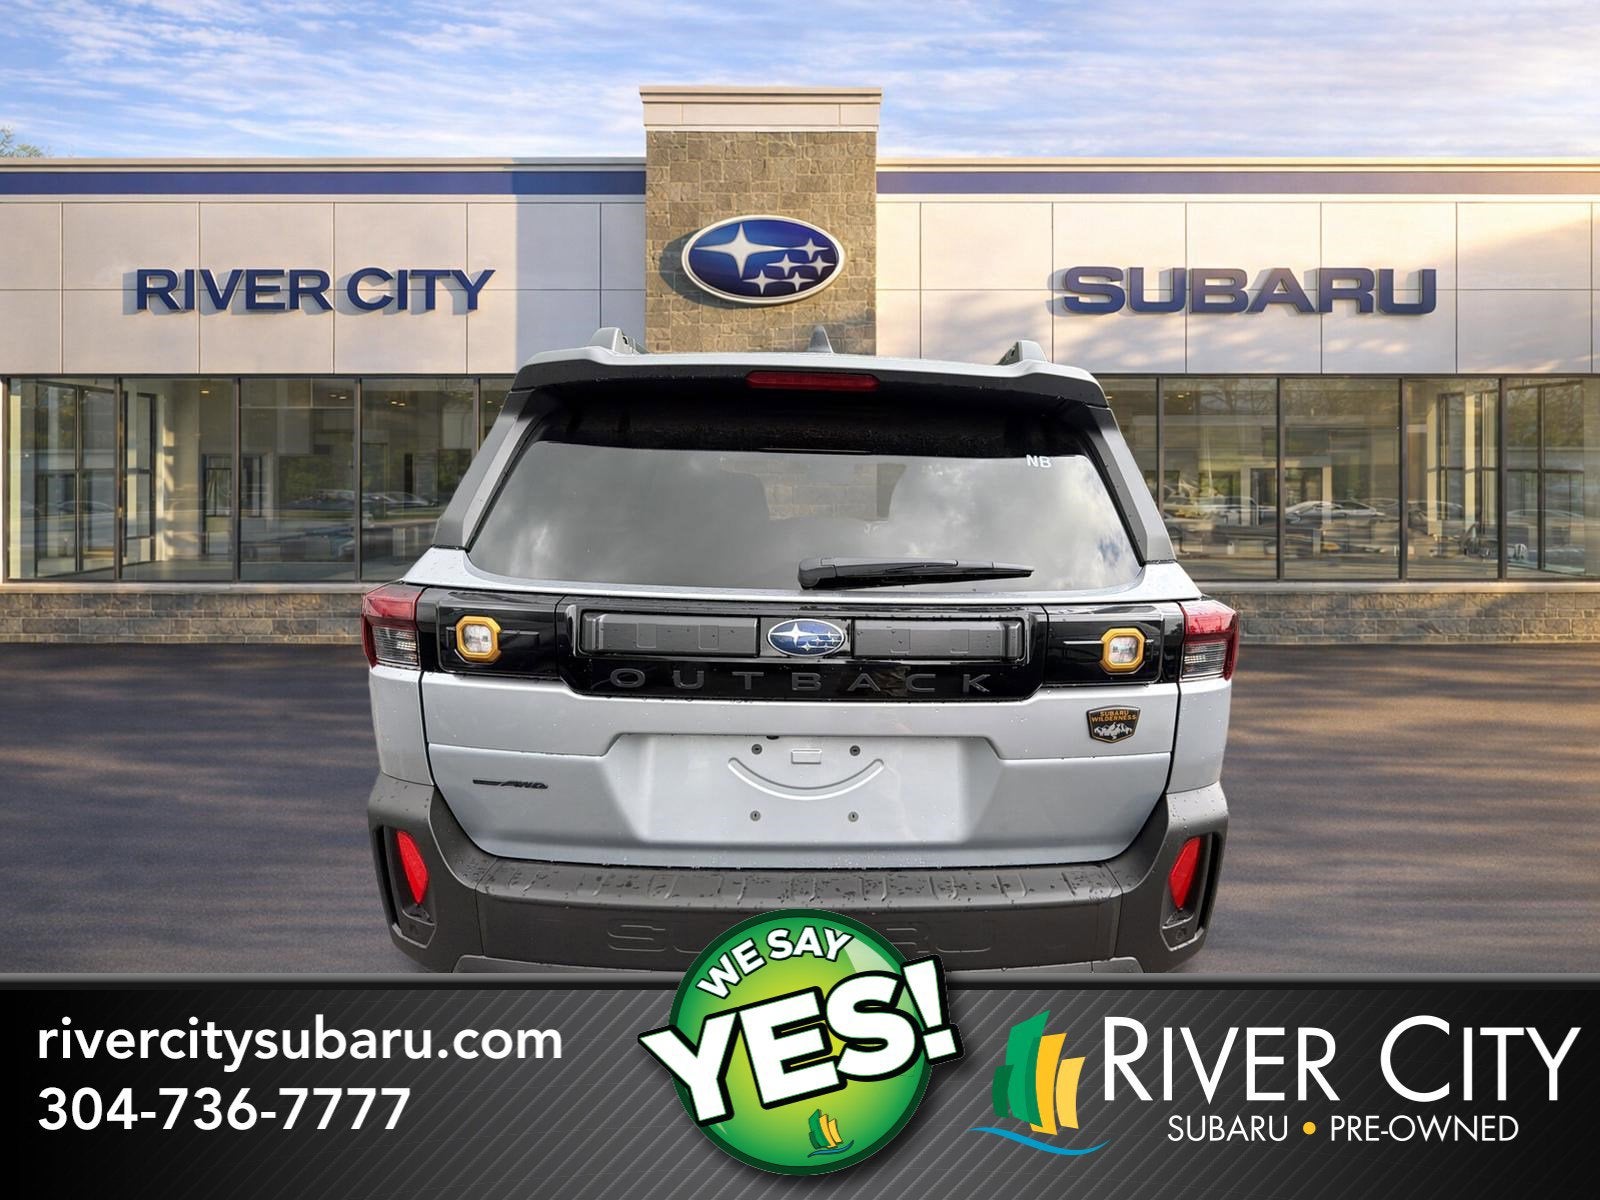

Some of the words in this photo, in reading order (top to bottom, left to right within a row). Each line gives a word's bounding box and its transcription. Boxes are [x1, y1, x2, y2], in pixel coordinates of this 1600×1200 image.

[137, 268, 333, 312] RIVER
[347, 267, 496, 312] CITY
[1063, 266, 1438, 315] SUBARU
[609, 667, 992, 693] OUTBACK
